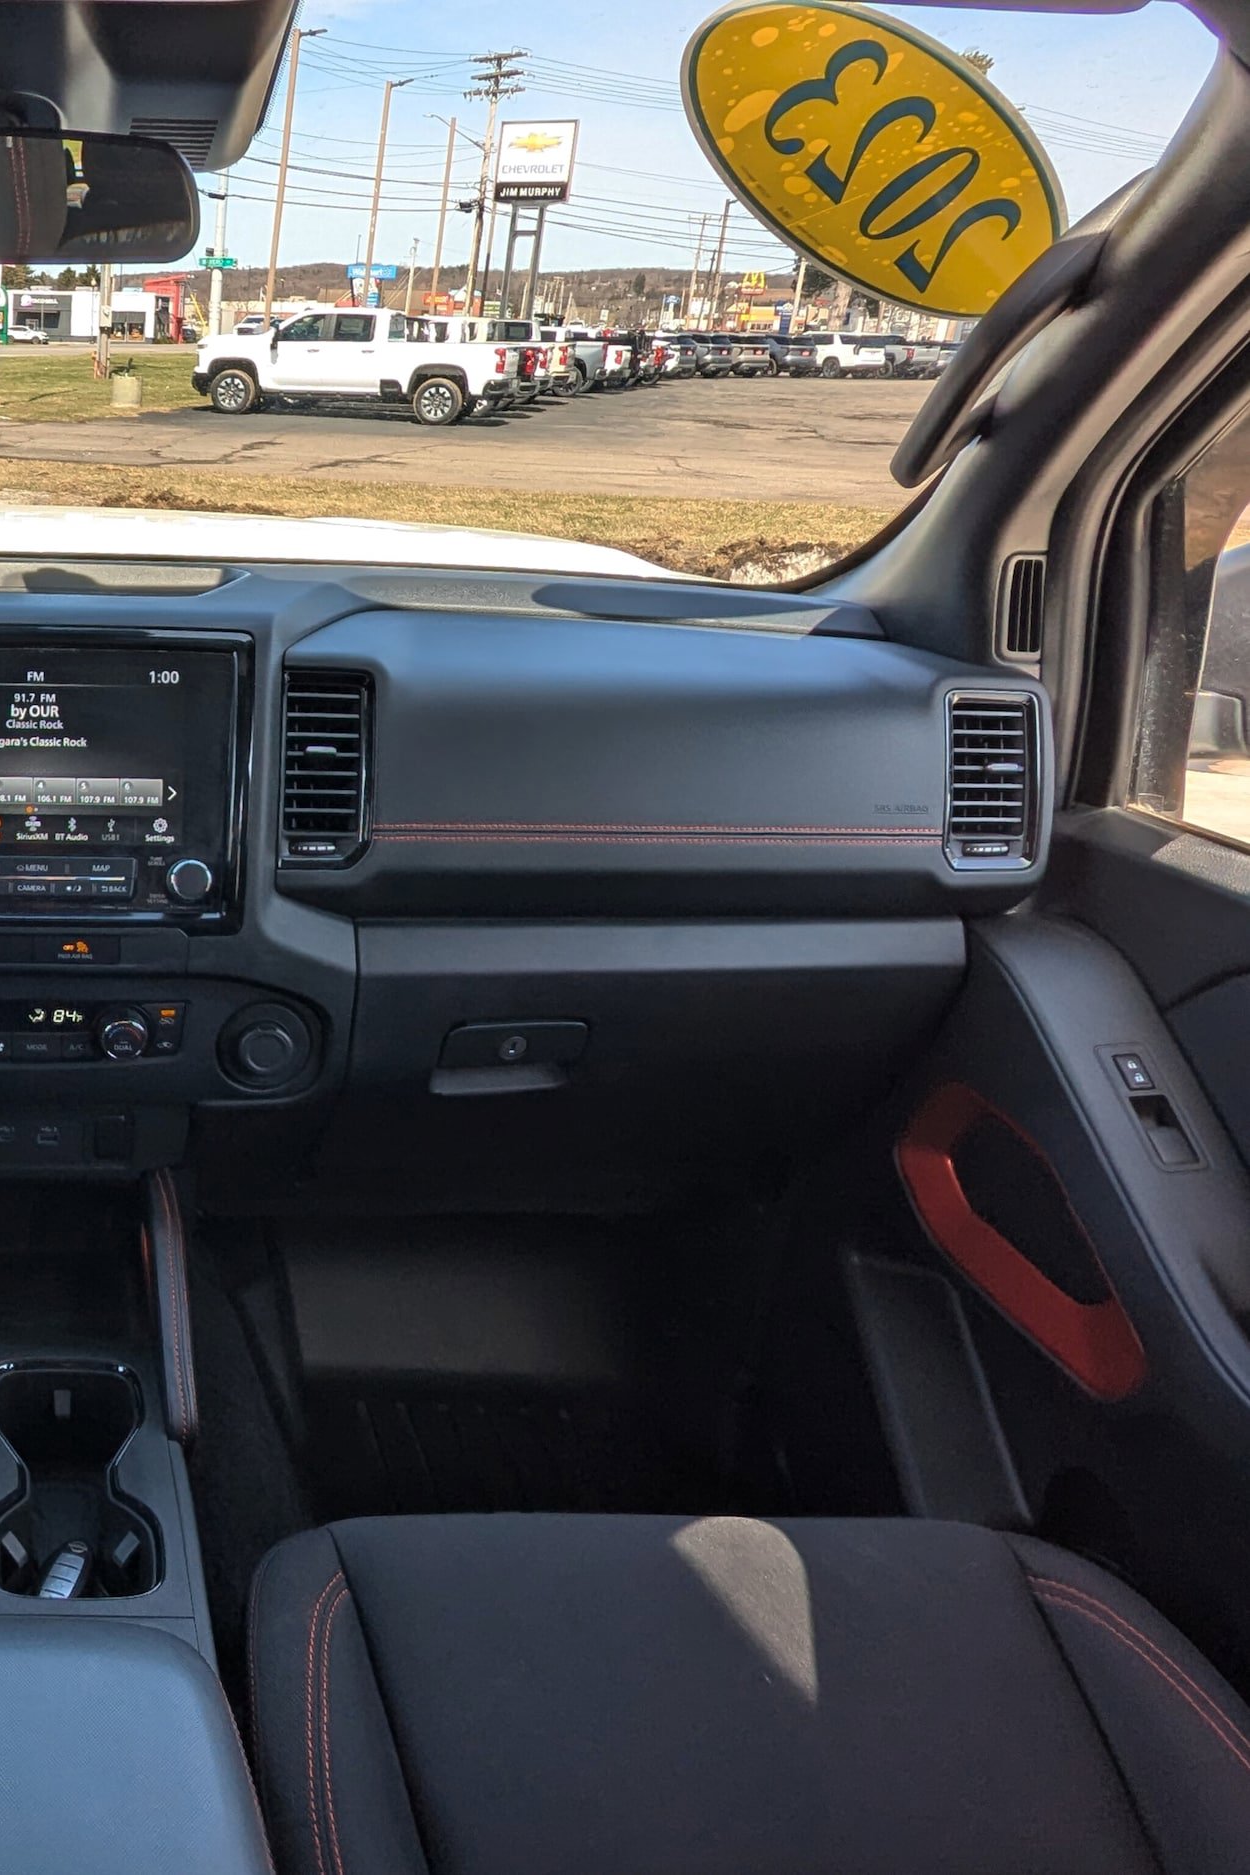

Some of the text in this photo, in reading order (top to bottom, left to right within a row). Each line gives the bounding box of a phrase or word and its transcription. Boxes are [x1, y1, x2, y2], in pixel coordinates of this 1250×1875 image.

[501, 164, 565, 174] CHEVROLET
[500, 187, 561, 197] JIM MURPHY
[27, 671, 45, 682] FM
[149, 670, 180, 684] 1:00
[13, 693, 56, 703] 91.7 FM
[10, 704, 59, 719] by OUR
[5, 719, 63, 729] Classic Rock
[29, 736, 62, 747] Classic
[63, 738, 88, 747] Rock
[80, 796, 116, 804] 107.9 FM
[124, 796, 144, 804] 107.9
[16, 832, 48, 841] SiriusXM
[66, 833, 88, 841] Audio
[144, 834, 175, 844] Settings
[25, 864, 48, 872] MENU
[92, 864, 111, 872] MAP
[109, 885, 127, 893] BACK
